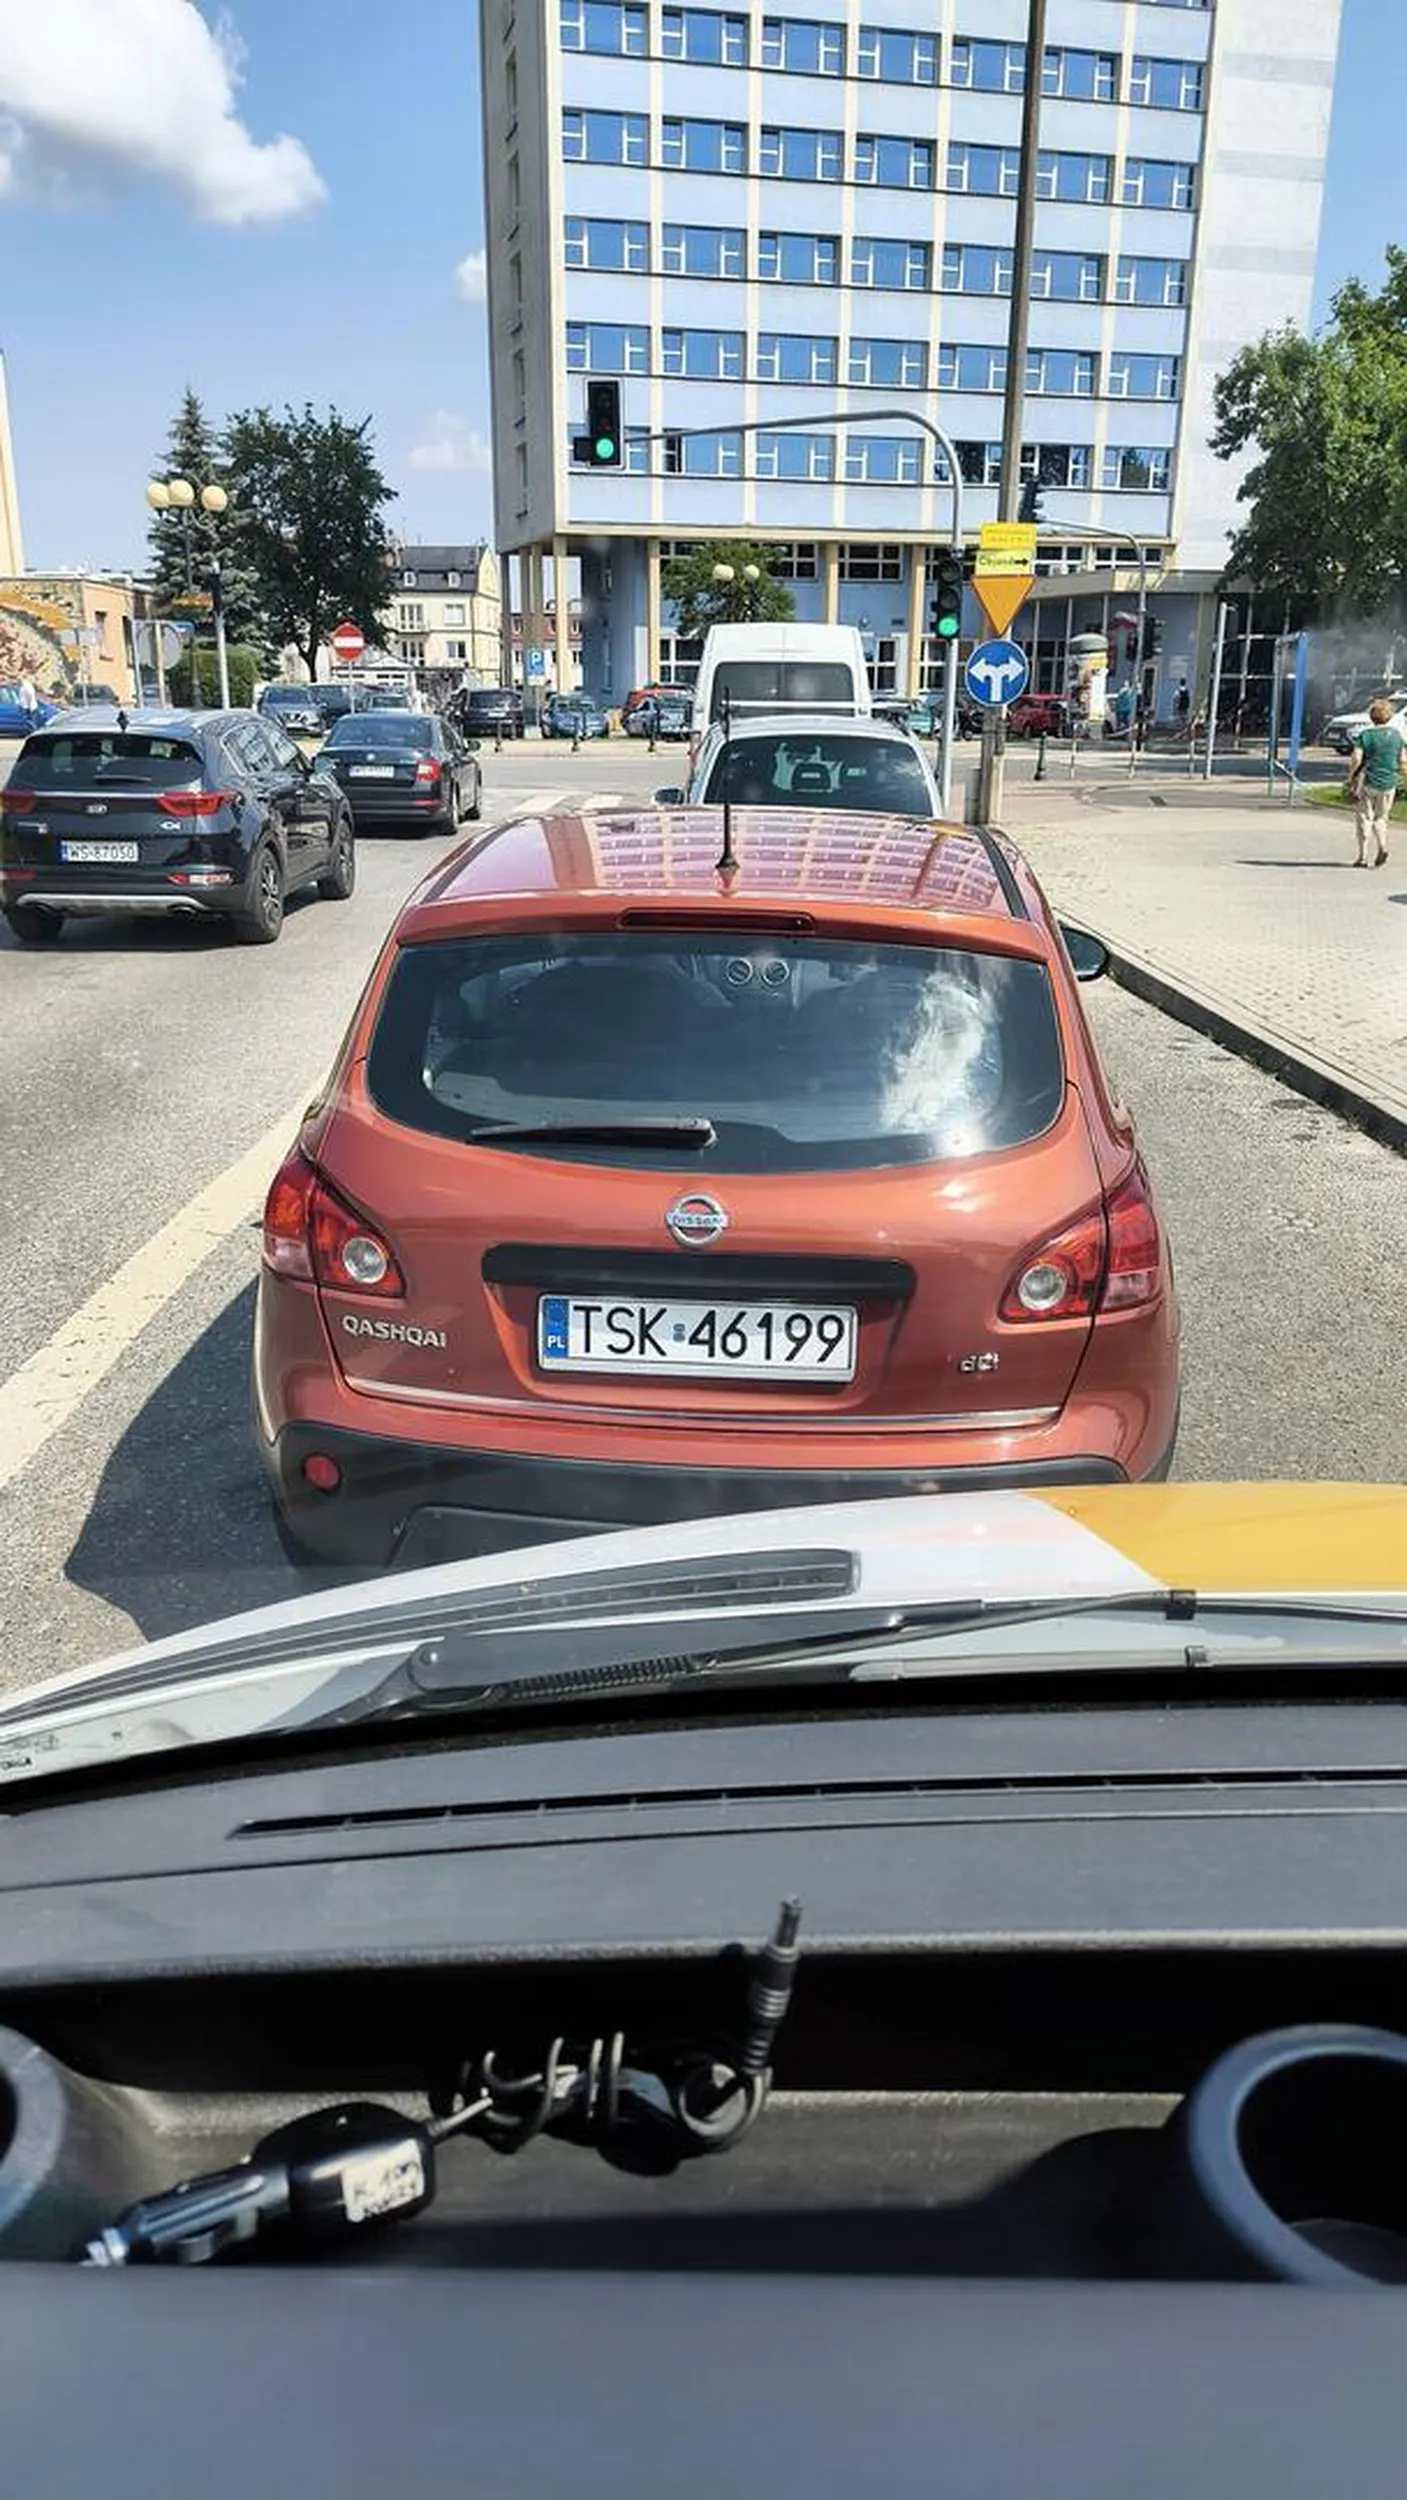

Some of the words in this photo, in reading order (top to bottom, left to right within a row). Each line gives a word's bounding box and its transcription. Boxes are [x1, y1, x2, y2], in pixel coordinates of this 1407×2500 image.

[342, 1315, 446, 1348] QASHQAI
[547, 1336, 565, 1348] PL
[573, 1305, 667, 1356] TSK
[688, 1309, 845, 1363] 46199
